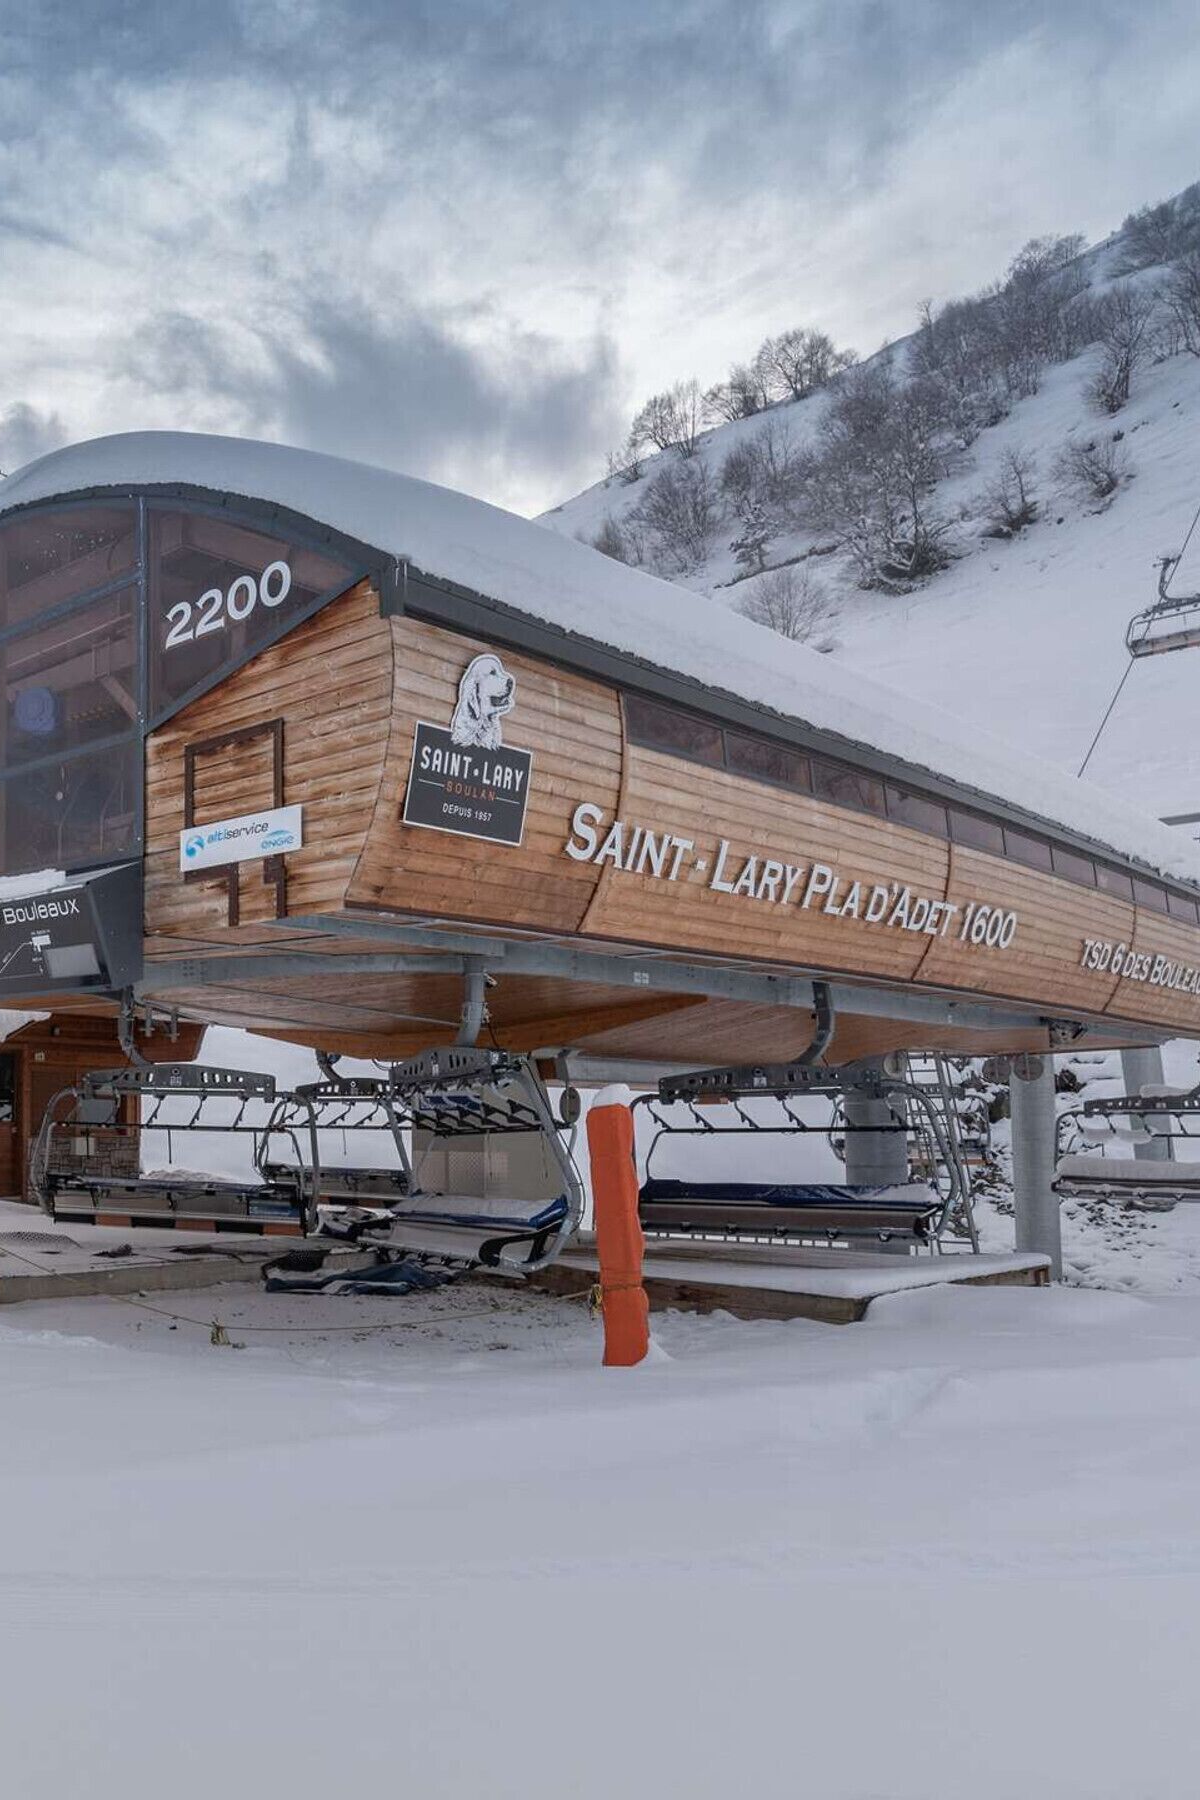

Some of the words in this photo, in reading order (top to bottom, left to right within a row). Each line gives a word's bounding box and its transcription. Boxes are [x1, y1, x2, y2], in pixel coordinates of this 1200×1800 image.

[165, 561, 292, 649] 2200
[446, 780, 497, 801] SOULAN
[442, 803, 473, 818] DEPUIS
[207, 821, 269, 844] altiservice
[3, 899, 80, 925] Bouleaux
[960, 902, 1017, 949] 1600
[1081, 939, 1113, 970] TSD
[1111, 943, 1126, 974] 6
